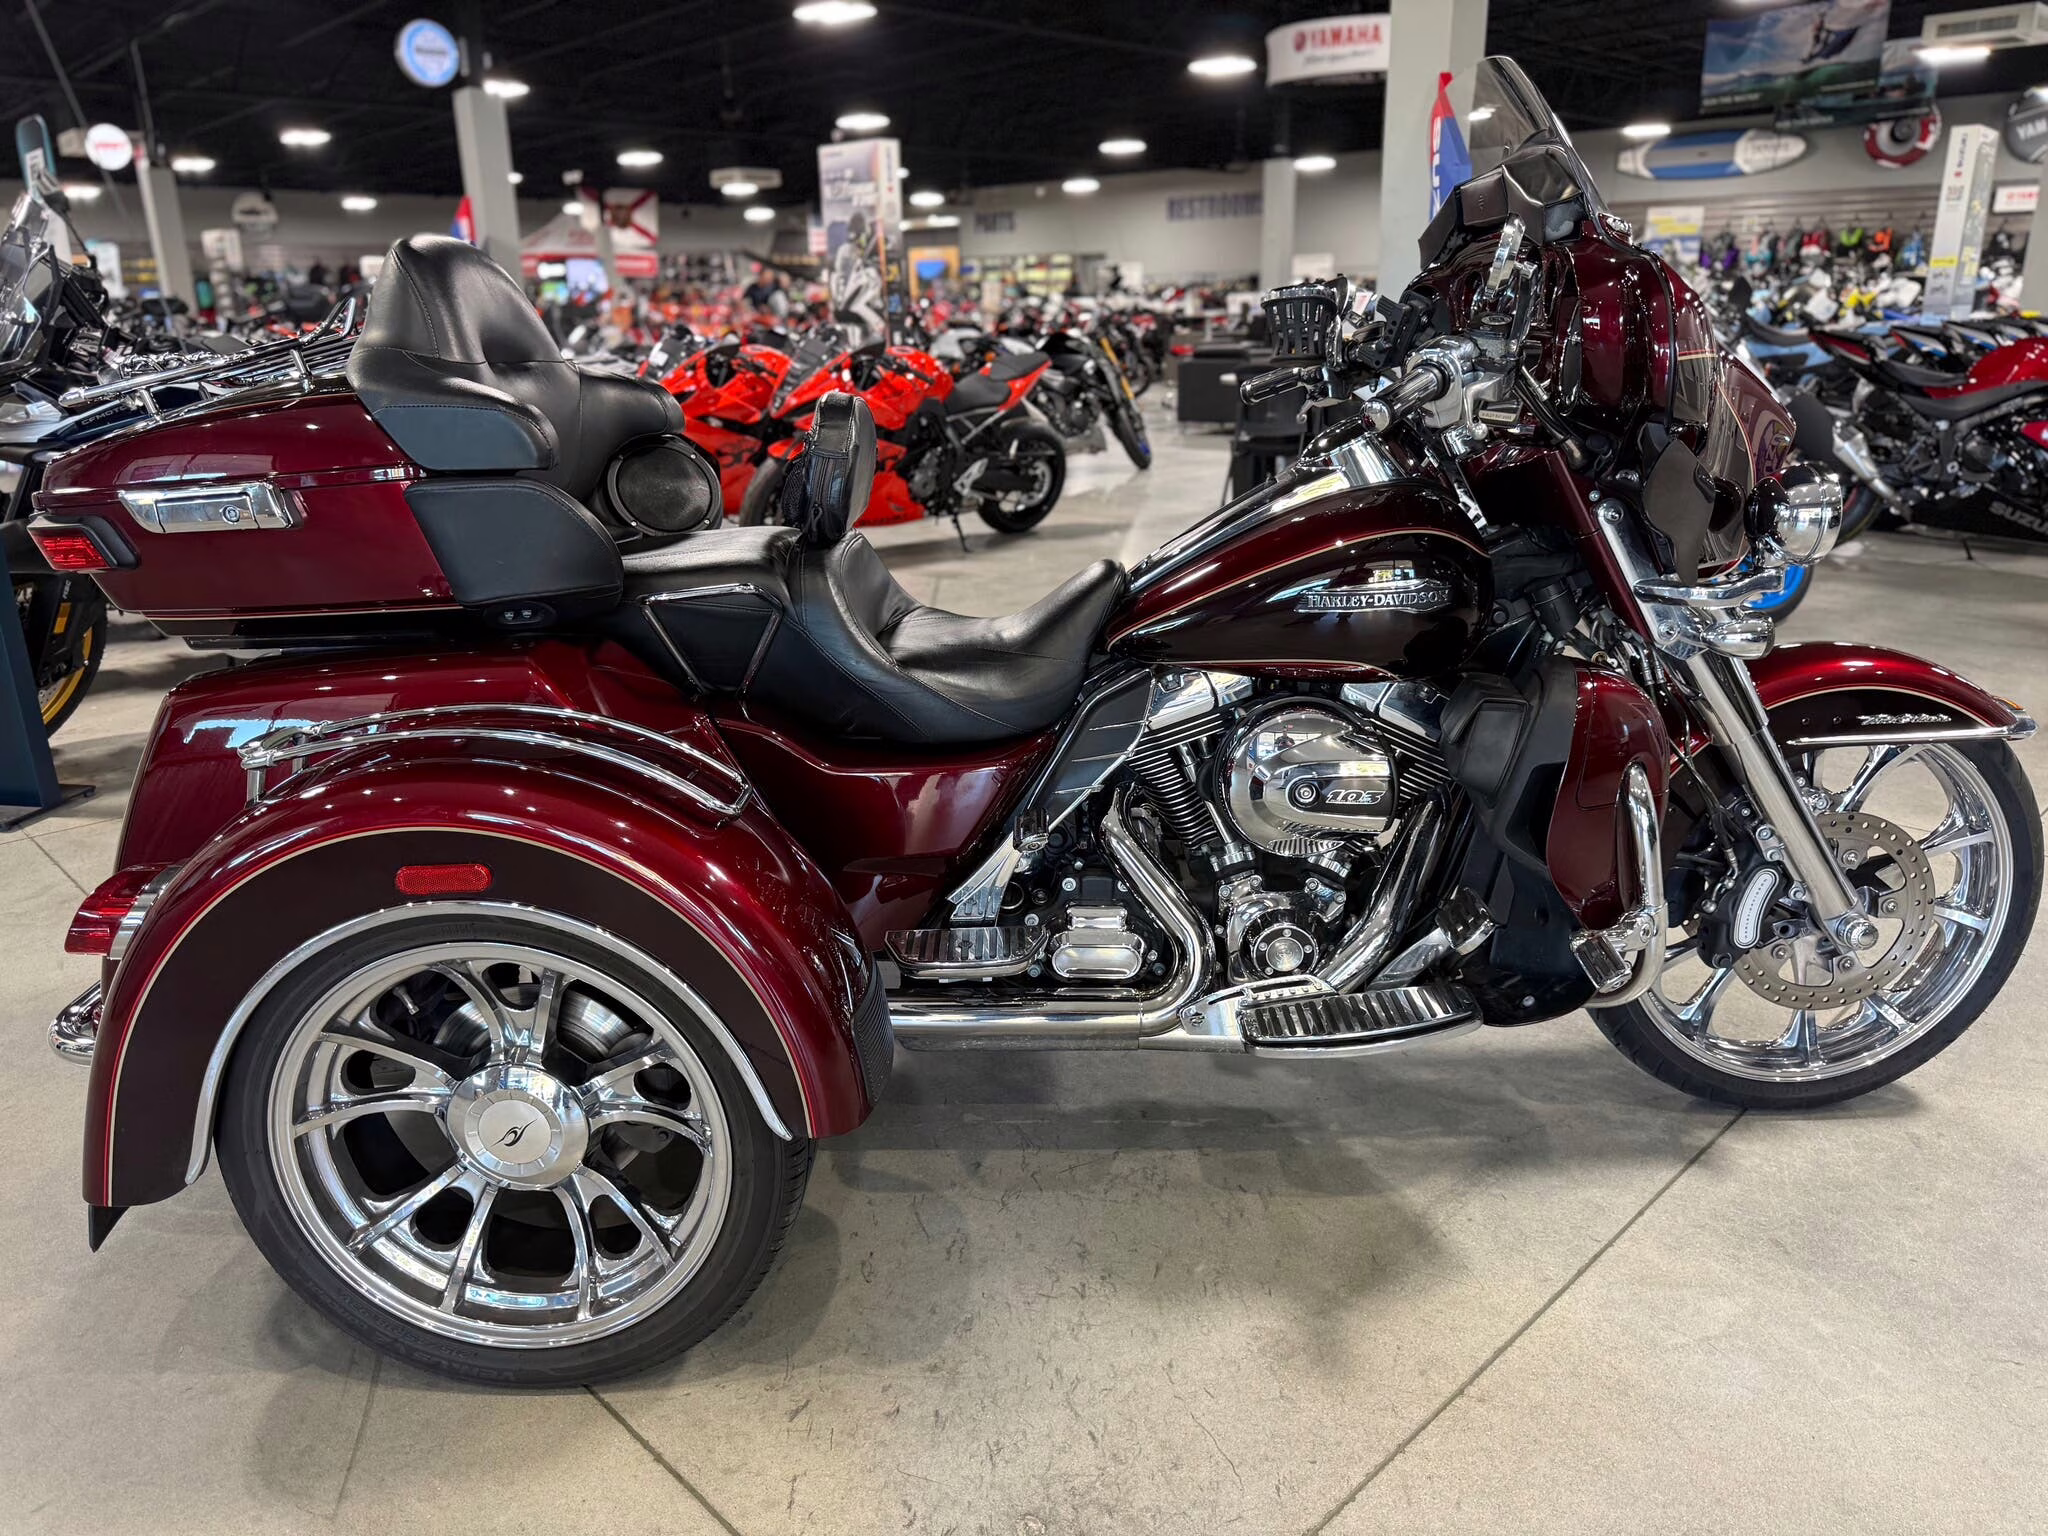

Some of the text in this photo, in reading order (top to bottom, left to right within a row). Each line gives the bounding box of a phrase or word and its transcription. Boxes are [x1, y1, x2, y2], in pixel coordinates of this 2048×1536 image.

[1310, 24, 1383, 49] YAMAHA
[1307, 589, 1449, 608] HARLEY-DAVIDSON
[1326, 790, 1386, 804] 103
